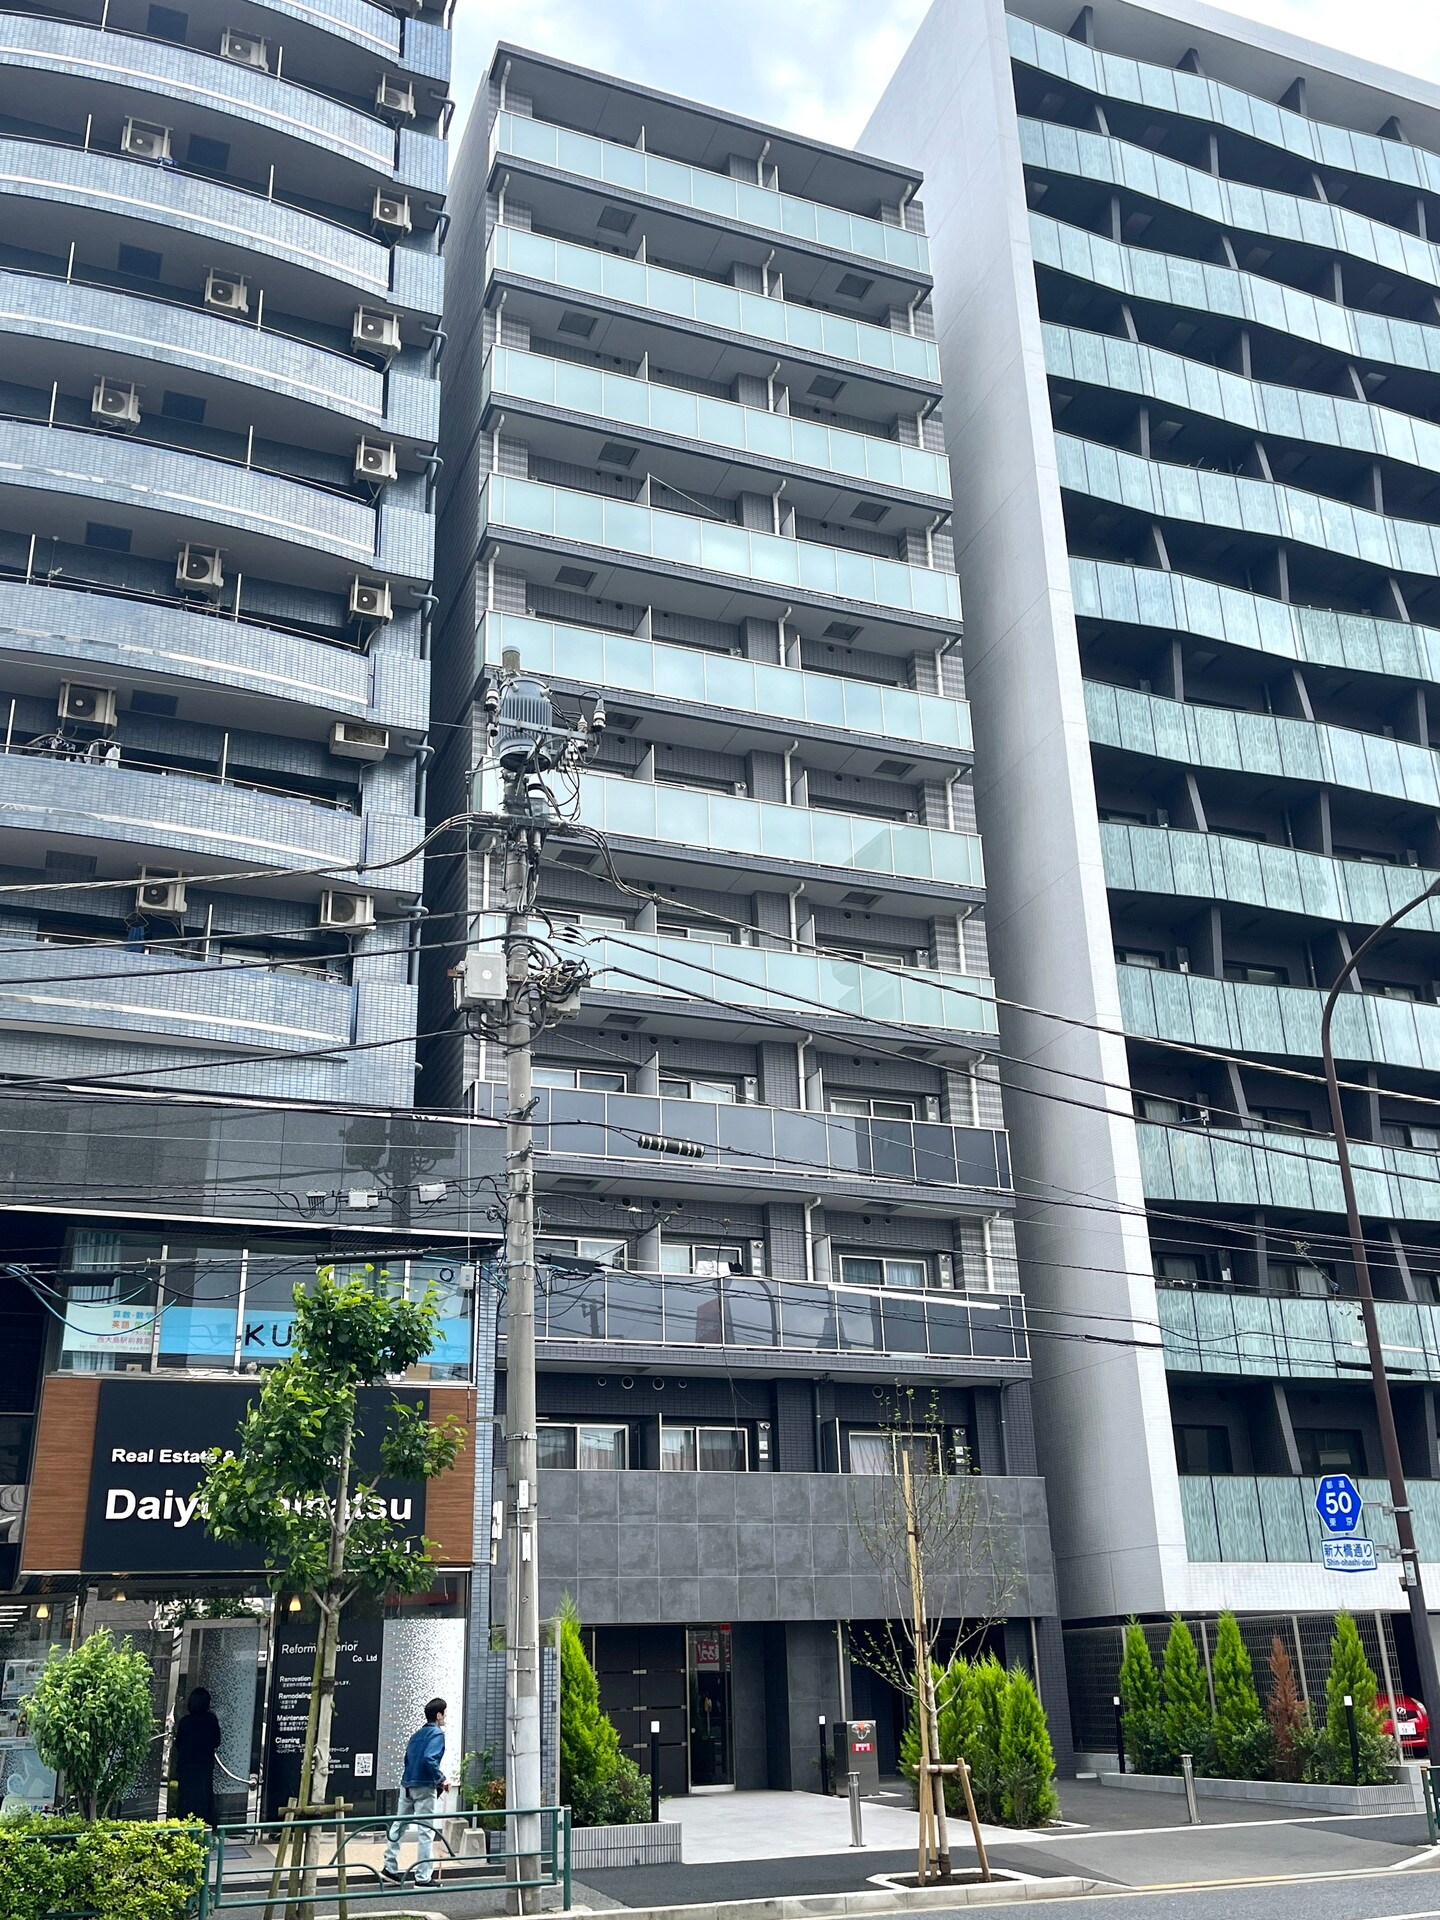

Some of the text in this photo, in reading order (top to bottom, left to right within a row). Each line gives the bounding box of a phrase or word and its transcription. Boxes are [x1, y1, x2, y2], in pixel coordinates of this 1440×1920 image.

[111, 1448, 153, 1463] Real
[159, 1449, 218, 1464] Estate
[1325, 1491, 1352, 1515] 50
[1324, 1543, 1373, 1558] 新大橋通り
[366, 1654, 378, 1662] Ltd
[279, 1675, 312, 1683] Renovation
[278, 1692, 312, 1700] Remodeling
